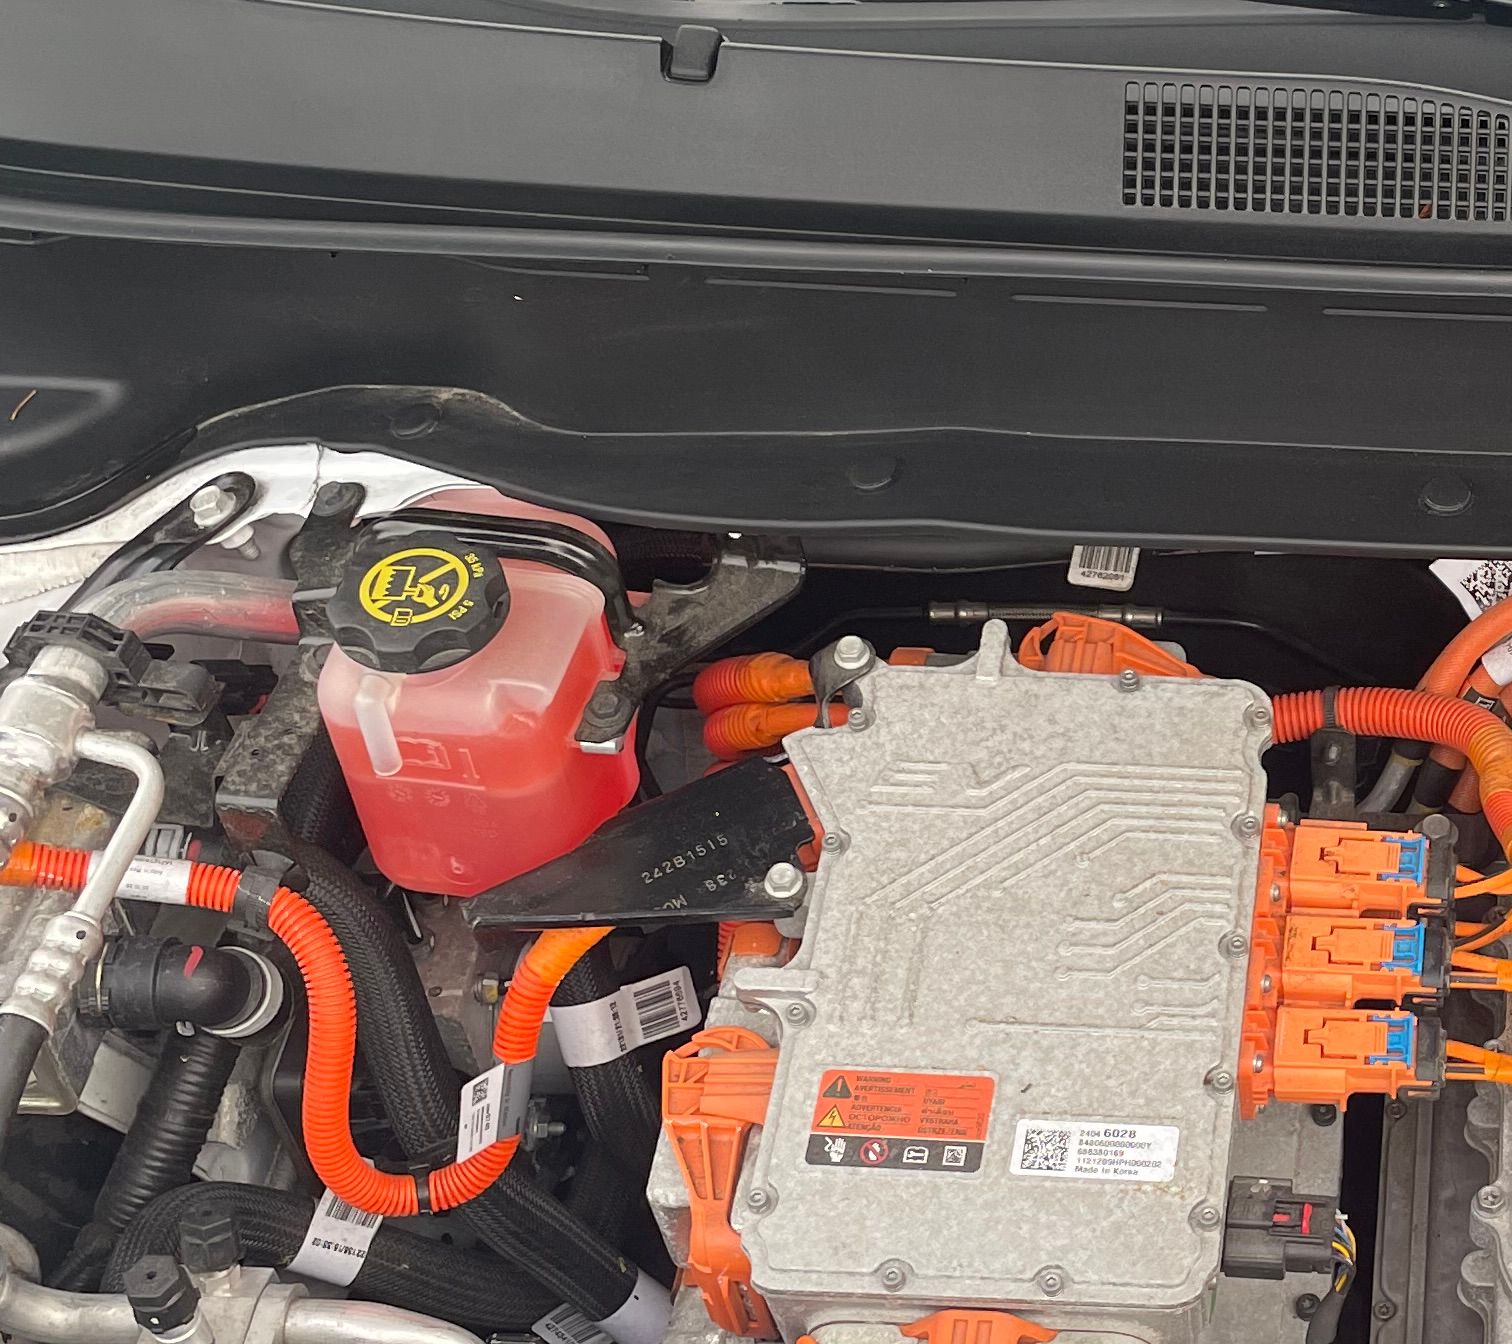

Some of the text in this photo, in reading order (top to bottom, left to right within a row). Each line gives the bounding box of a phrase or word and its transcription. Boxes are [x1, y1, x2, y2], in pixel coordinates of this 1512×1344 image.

[448, 606, 467, 620] PSI
[641, 834, 728, 884] 242B1515
[855, 1085, 915, 1094] AVERTISSEMENT
[1075, 1165, 1098, 1173] Made
[1114, 1167, 1138, 1175] Korea
